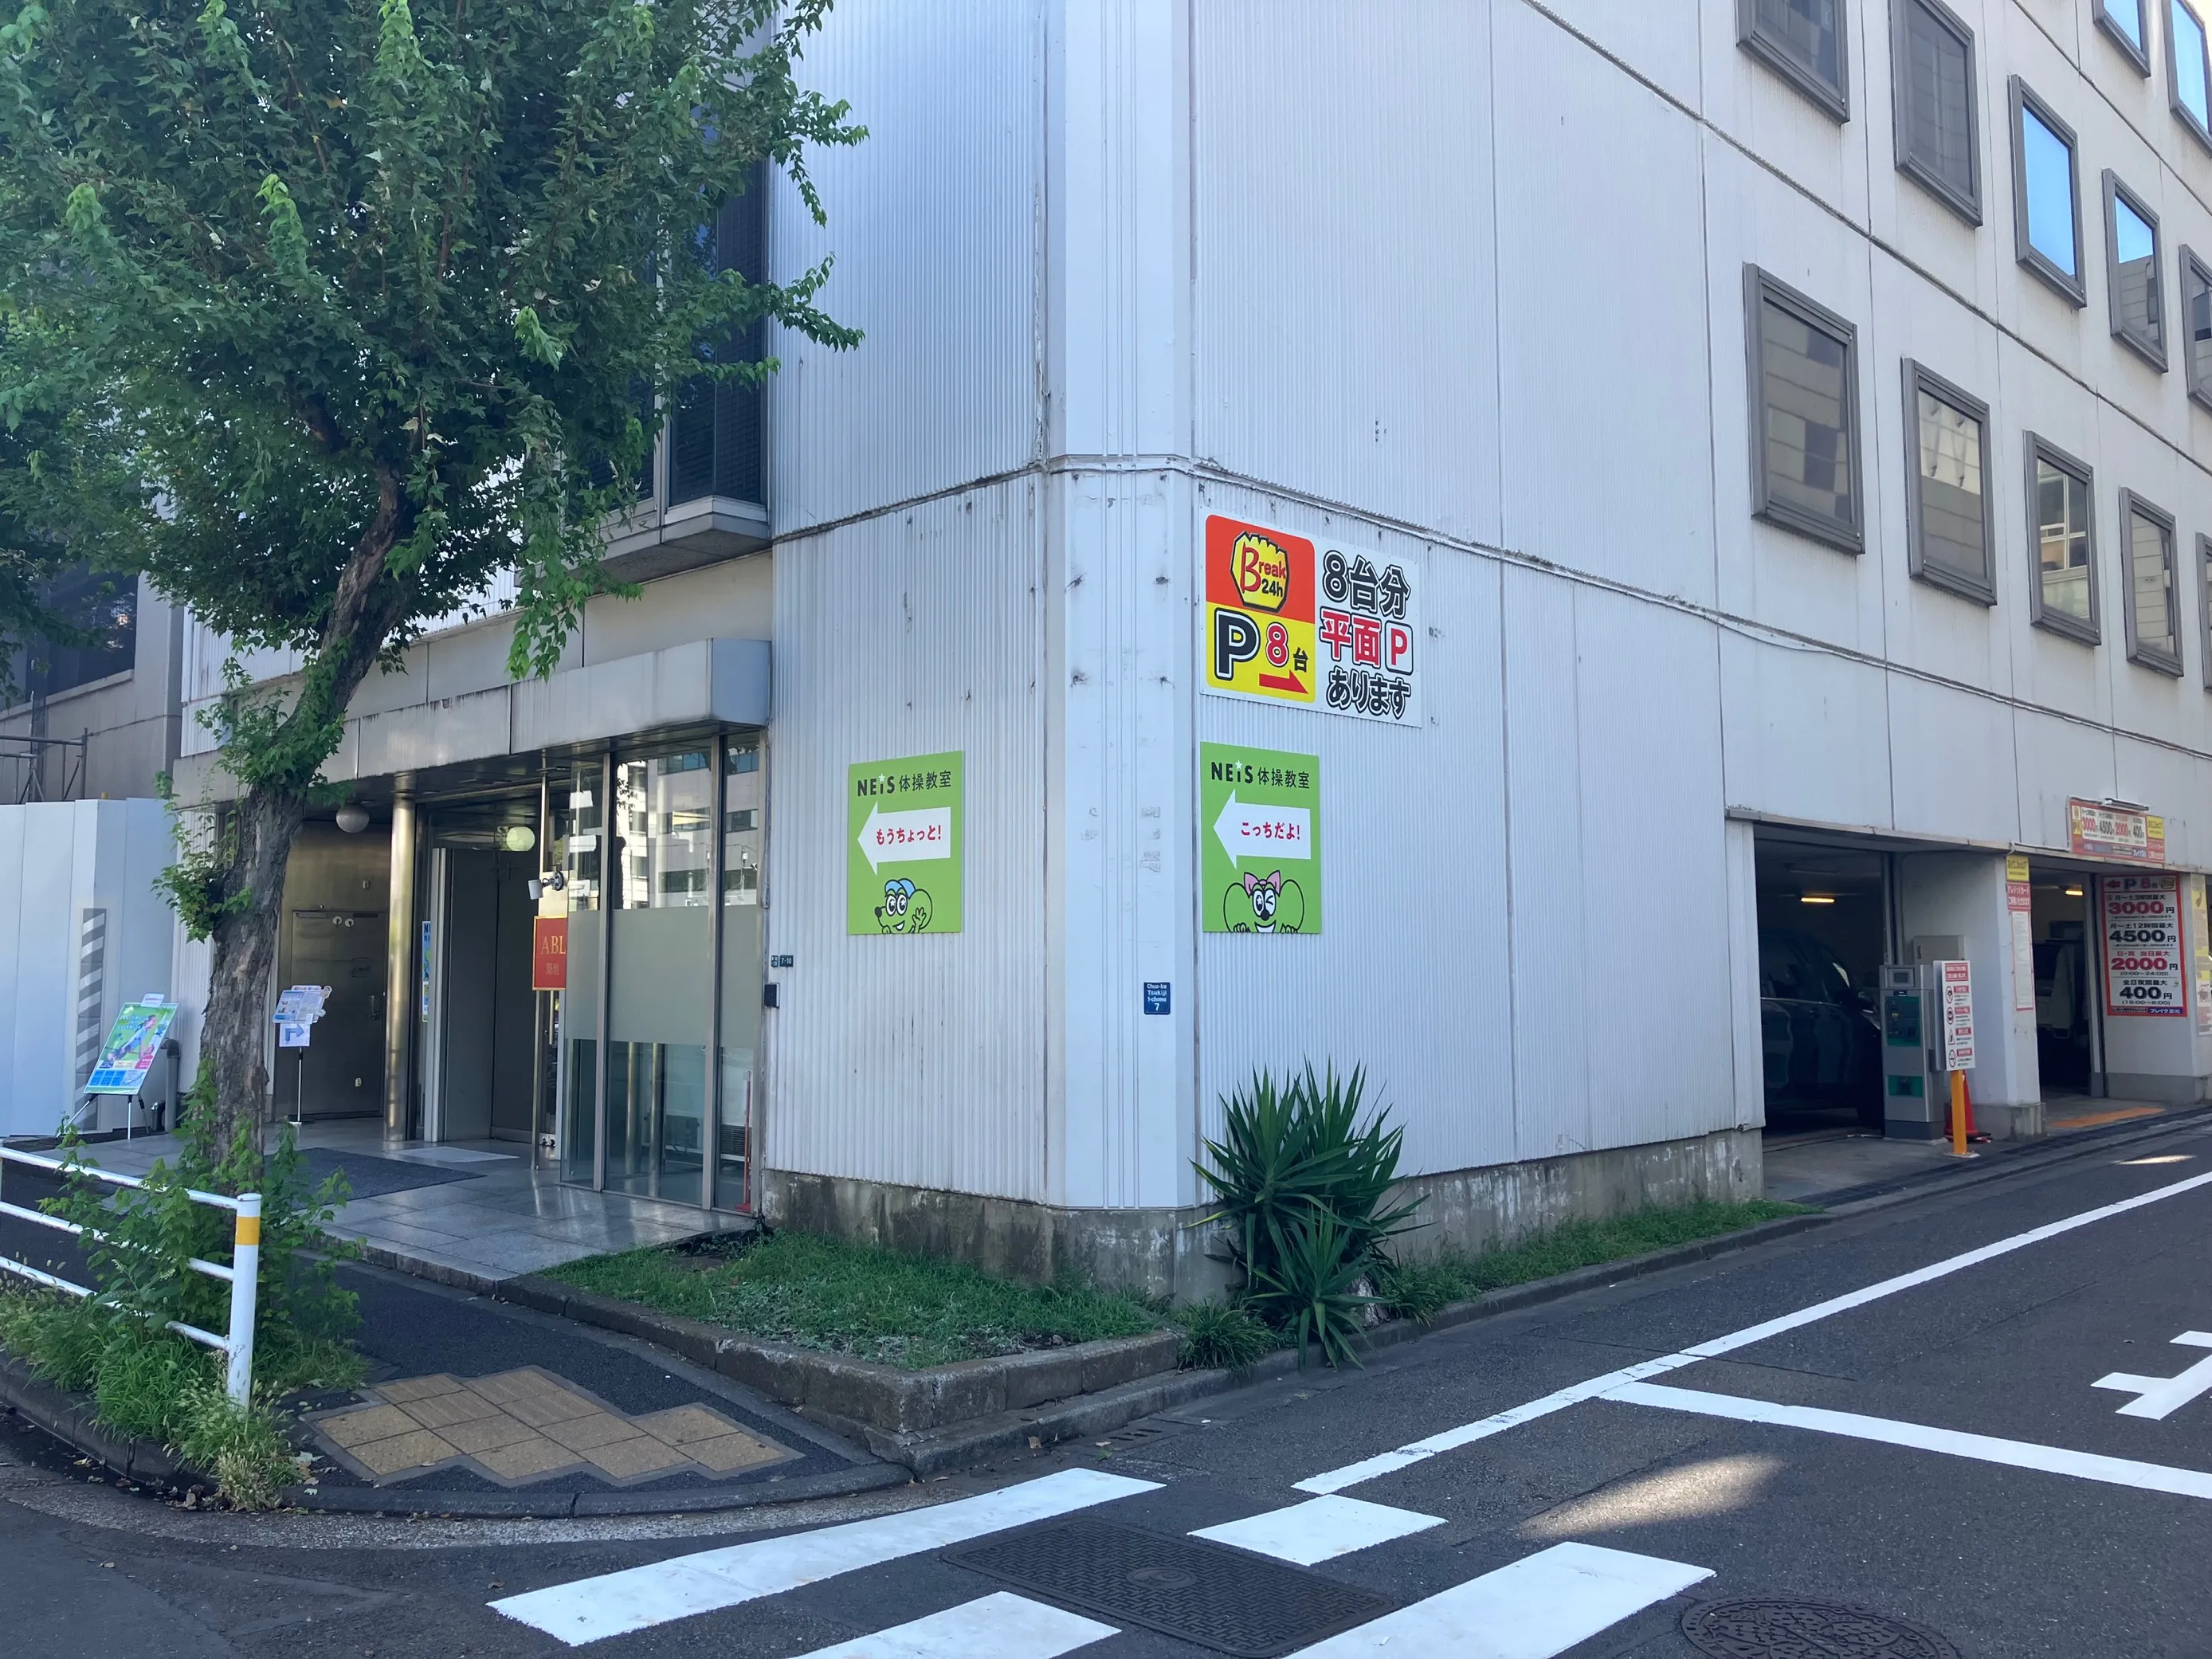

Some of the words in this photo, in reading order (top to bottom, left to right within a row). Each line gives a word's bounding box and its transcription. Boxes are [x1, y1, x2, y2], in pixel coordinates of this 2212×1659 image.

[1240, 541, 1286, 594] Break
[1322, 550, 1411, 619] 8台分
[1261, 578, 1284, 598] 24h
[1214, 607, 1261, 681] P
[1326, 666, 1412, 720] あります
[899, 770, 951, 792] 体操教室
[1257, 767, 1310, 789] 体操教室
[540, 935, 566, 955] ABL
